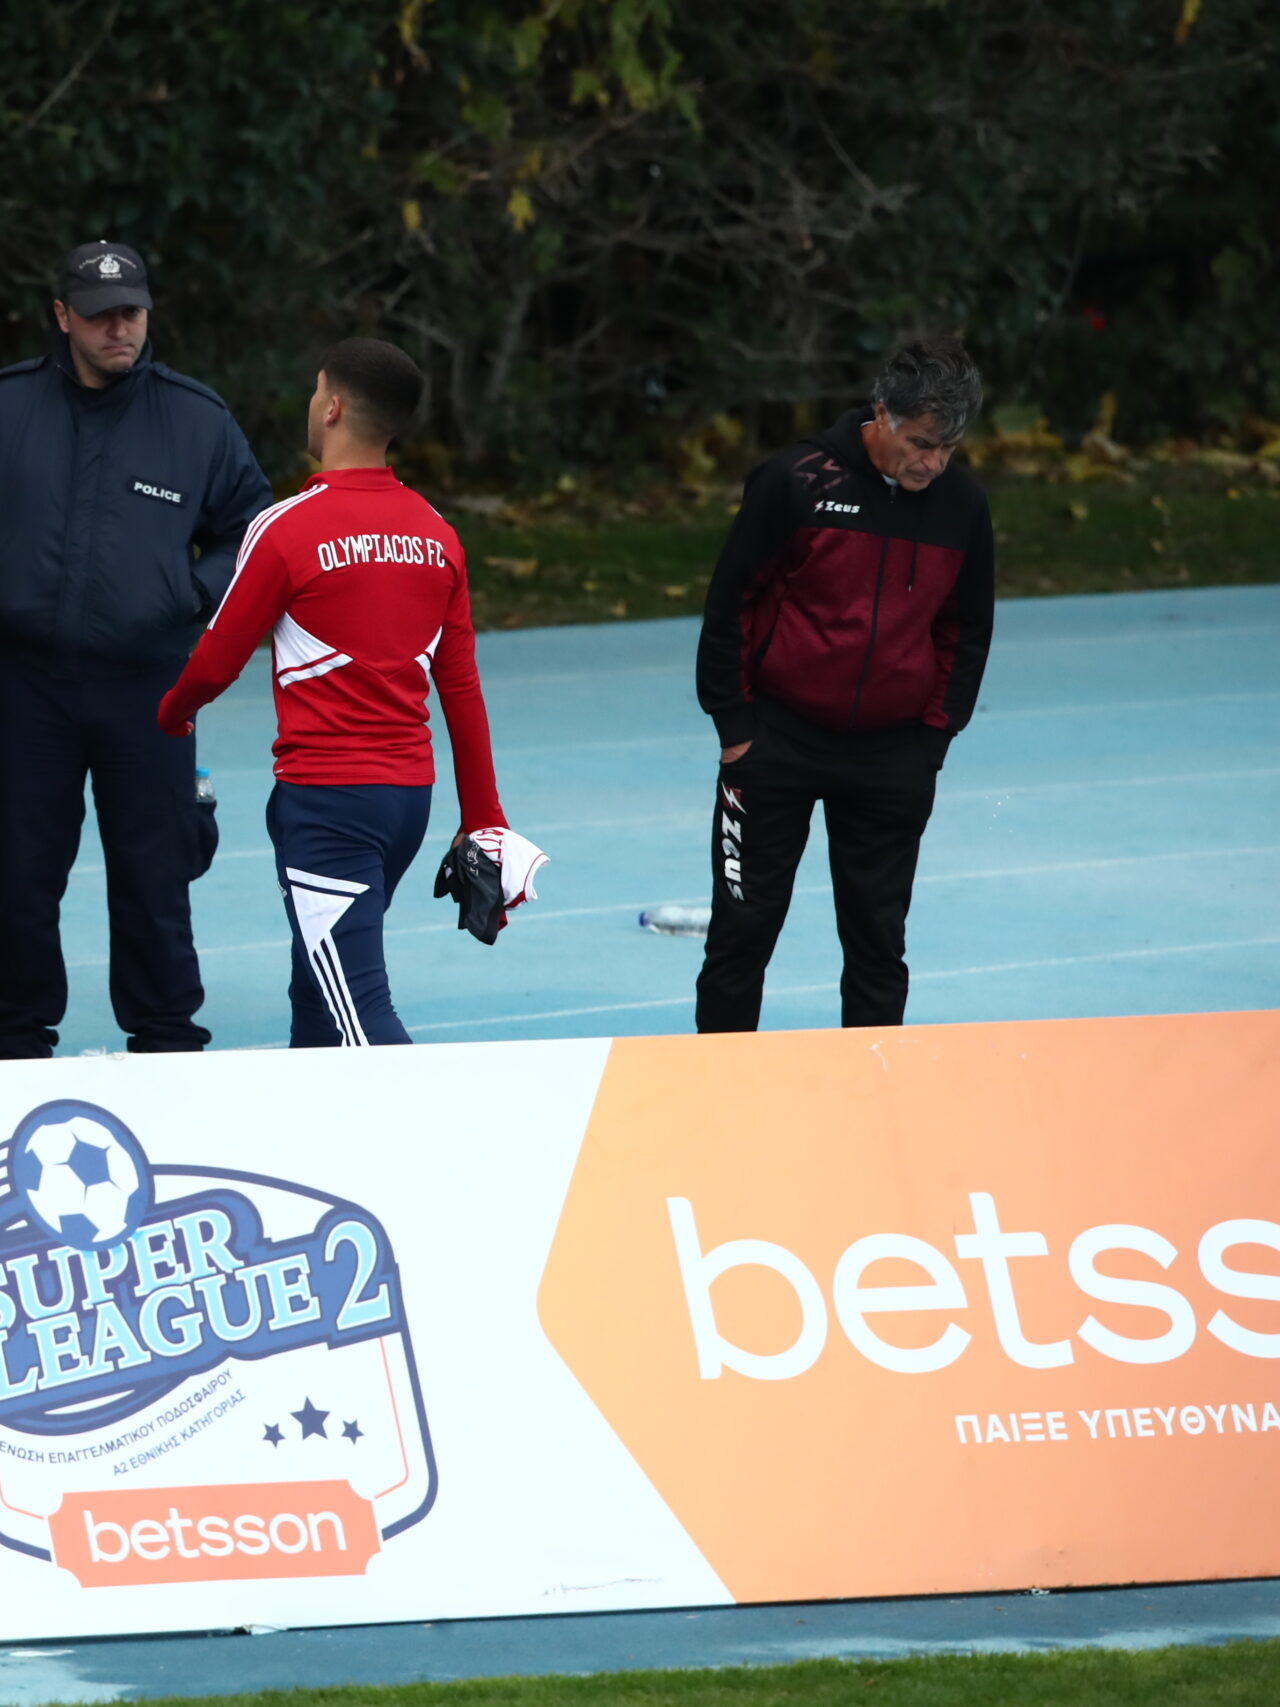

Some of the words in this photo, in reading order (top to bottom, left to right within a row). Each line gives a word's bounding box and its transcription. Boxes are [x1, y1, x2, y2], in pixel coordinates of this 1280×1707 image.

[134, 481, 181, 503] POLICE
[825, 500, 861, 514] Zeus
[317, 534, 424, 572] OLYMPIACOS
[425, 538, 446, 568] FC
[721, 809, 745, 901] Zeus
[324, 1219, 392, 1331] 2
[49, 1423, 156, 1464] ΕΠΑΓΓΕΛΜΑΤΙΚΟΥ
[156, 1368, 233, 1428] ΠΟΔΟΣΦΑΙΡΟΥ
[132, 1434, 182, 1470] ΕΘΝΙΚΗΣ
[182, 1388, 247, 1440] ΚΑΤΗΓΟΡΙΑΣ
[954, 1411, 1069, 1444] ΠΑΙΞΕ
[1078, 1402, 1280, 1439] ΥΠΕΥΘΥΝΑ
[83, 1507, 347, 1563] betsson
